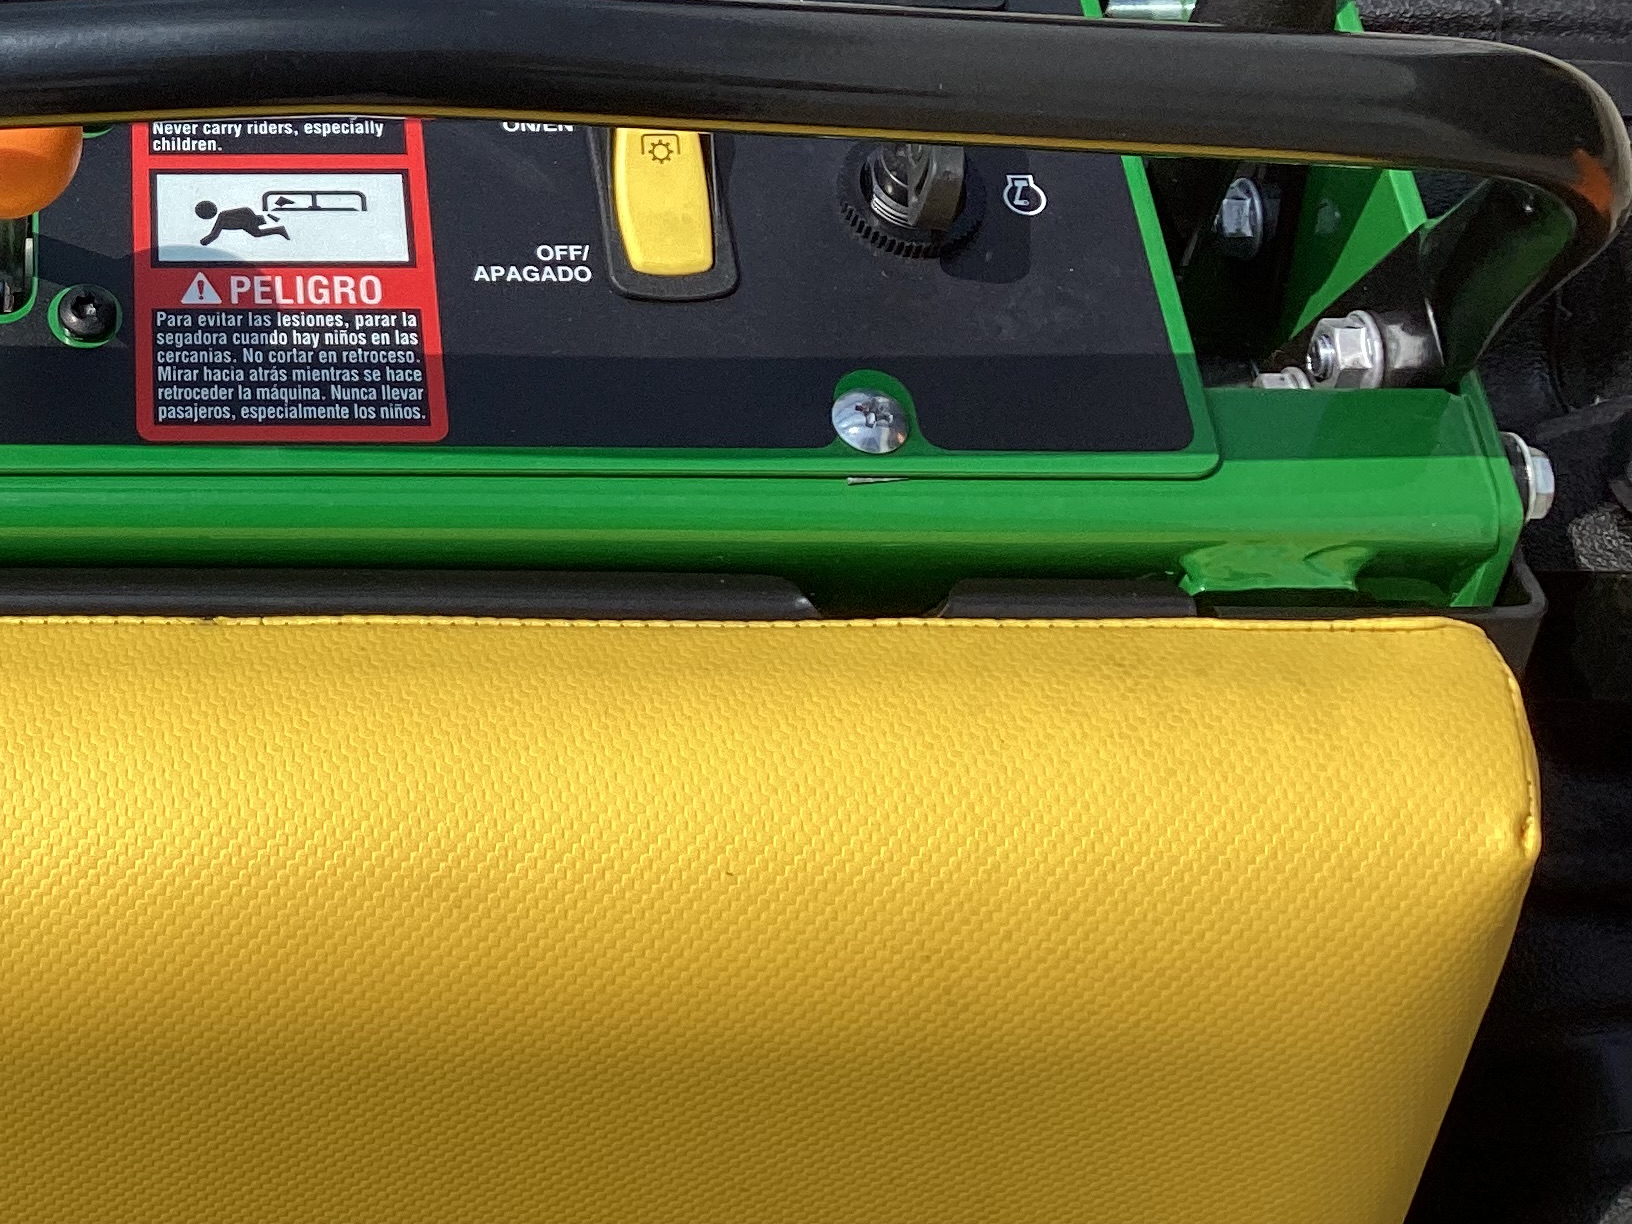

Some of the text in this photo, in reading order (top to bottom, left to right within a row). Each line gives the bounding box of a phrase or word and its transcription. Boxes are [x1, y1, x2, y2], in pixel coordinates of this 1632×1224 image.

[153, 119, 384, 137] Never carry riders, especially
[153, 137, 222, 151] children.
[537, 245, 589, 260] OFF/
[474, 266, 592, 282] APAGADO
[231, 276, 382, 304] PELIGRO
[157, 312, 416, 330] Para evitar las lesiones, parar la
[157, 330, 418, 348] segadora cuando hay niños en las
[243, 348, 262, 362] No
[269, 348, 314, 362] cortar
[319, 351, 337, 363] en
[342, 348, 420, 363] retroceso.
[158, 366, 422, 381] Mirar hacia atrás mientras se hace
